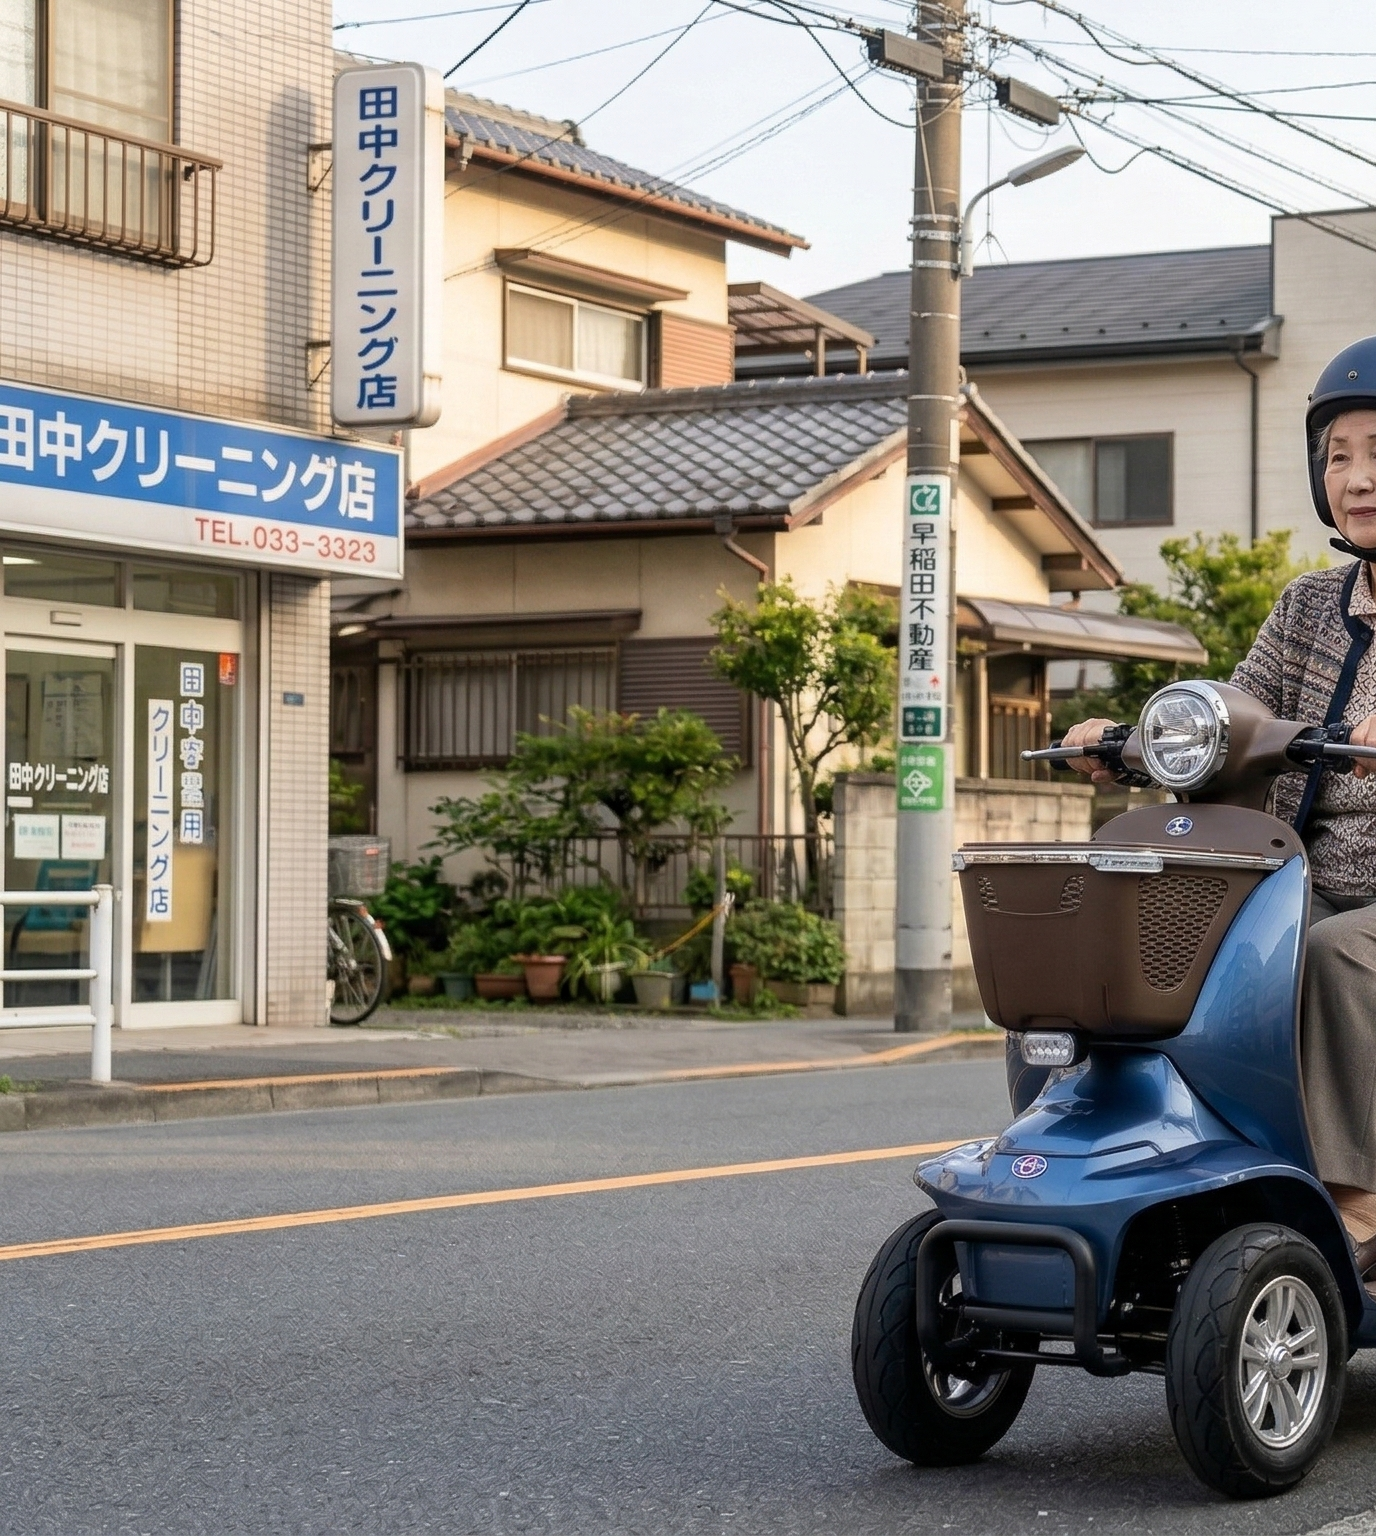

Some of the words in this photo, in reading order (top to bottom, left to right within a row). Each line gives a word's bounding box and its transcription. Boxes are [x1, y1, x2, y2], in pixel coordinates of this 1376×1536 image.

[357, 86, 398, 409] 田中クリーニング店
[0, 404, 376, 522] 田中クリーニング店
[195, 517, 376, 563] TEL.033-3323
[908, 522, 937, 671] 早稲田不動産
[9, 762, 109, 794] 田中クリーニング店
[150, 706, 169, 914] クリーニング店
